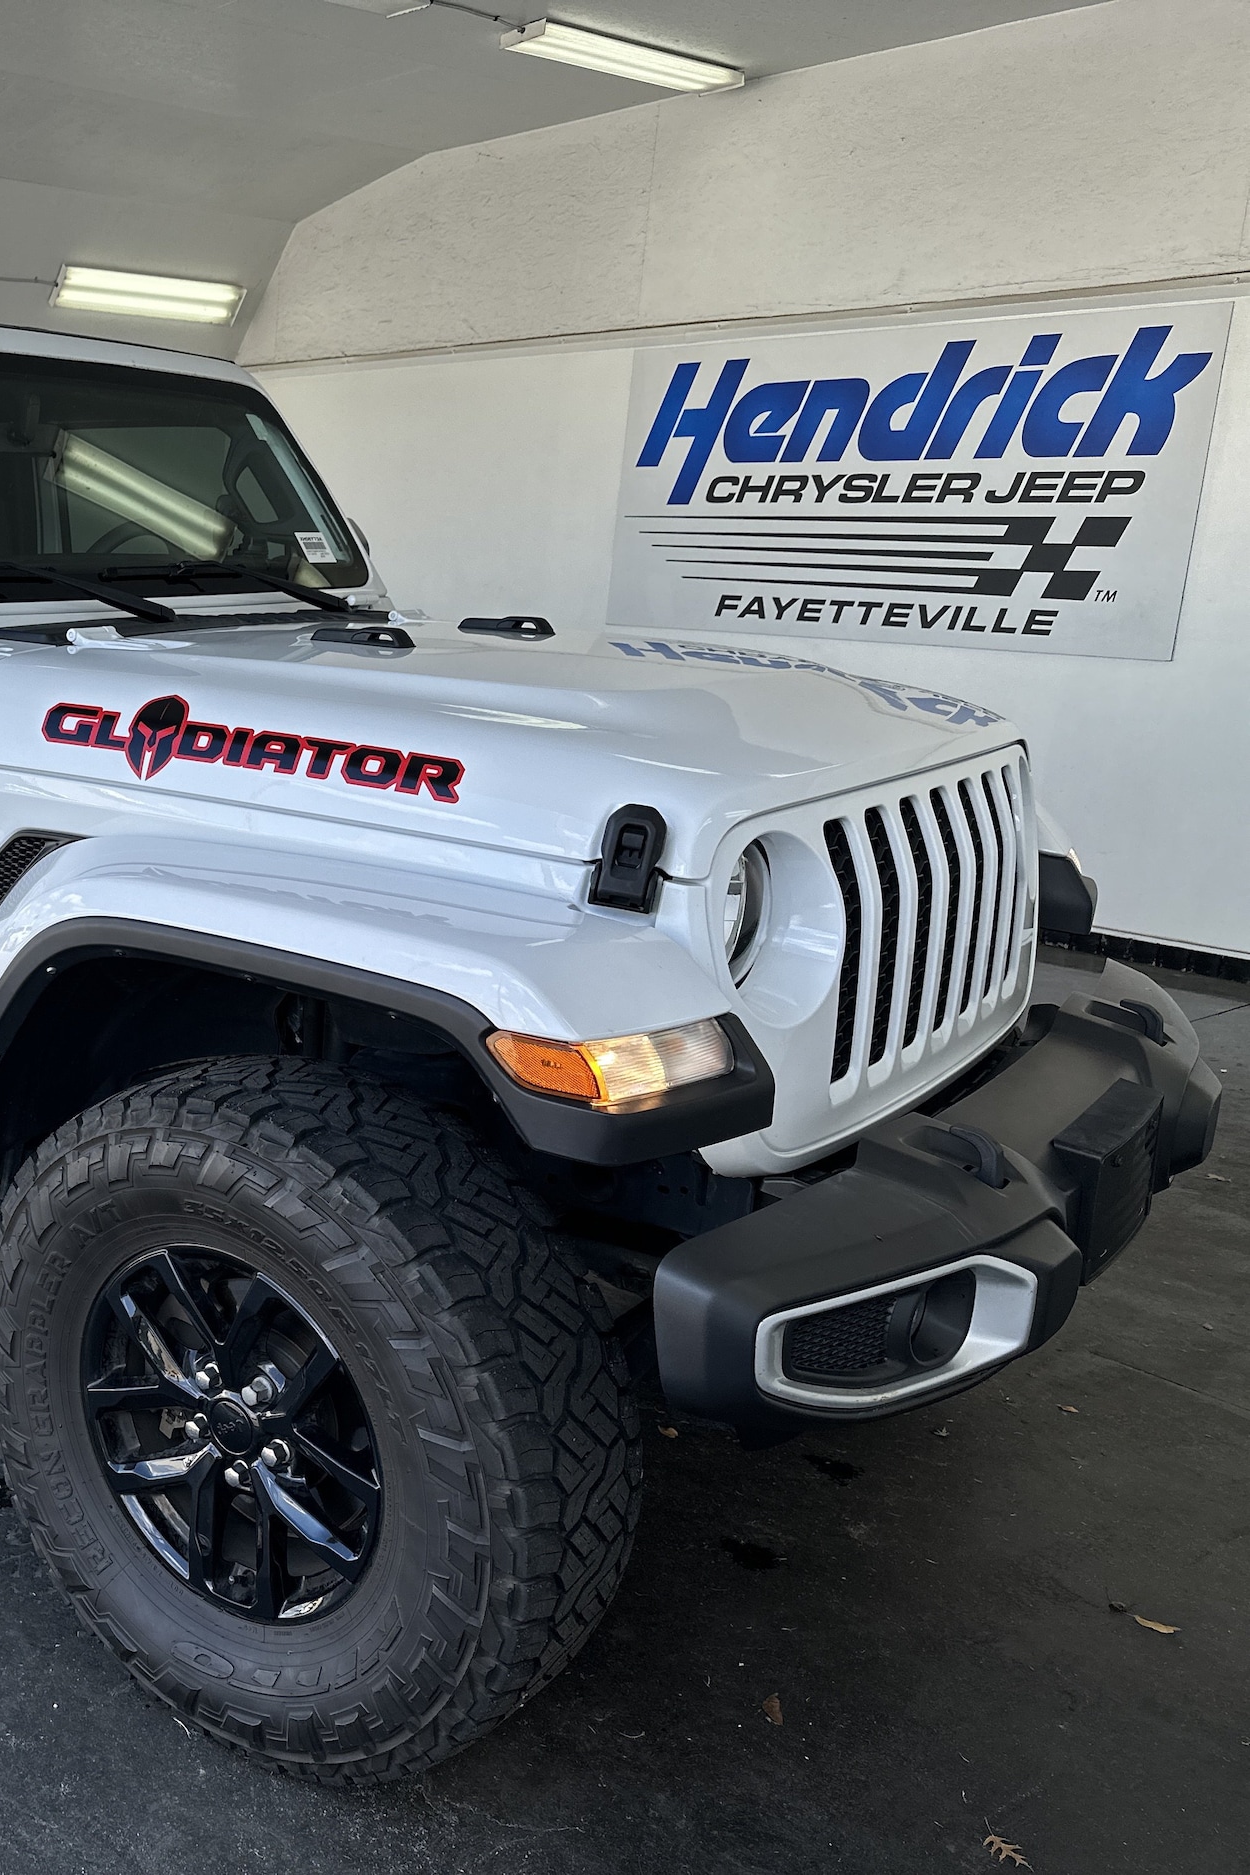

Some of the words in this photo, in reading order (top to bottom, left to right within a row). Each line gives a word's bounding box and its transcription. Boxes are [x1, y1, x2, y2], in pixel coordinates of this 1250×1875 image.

[636, 325, 1213, 505] Hendrick
[706, 472, 977, 504] CHRYSLER
[985, 470, 1147, 503] JEEP
[714, 594, 1060, 636] FAYETTEVILLE
[1094, 589, 1118, 603] TM
[69, 1198, 123, 1250] A/T
[24, 1251, 73, 1438] GRAPPLER
[39, 1448, 114, 1576] RECON
